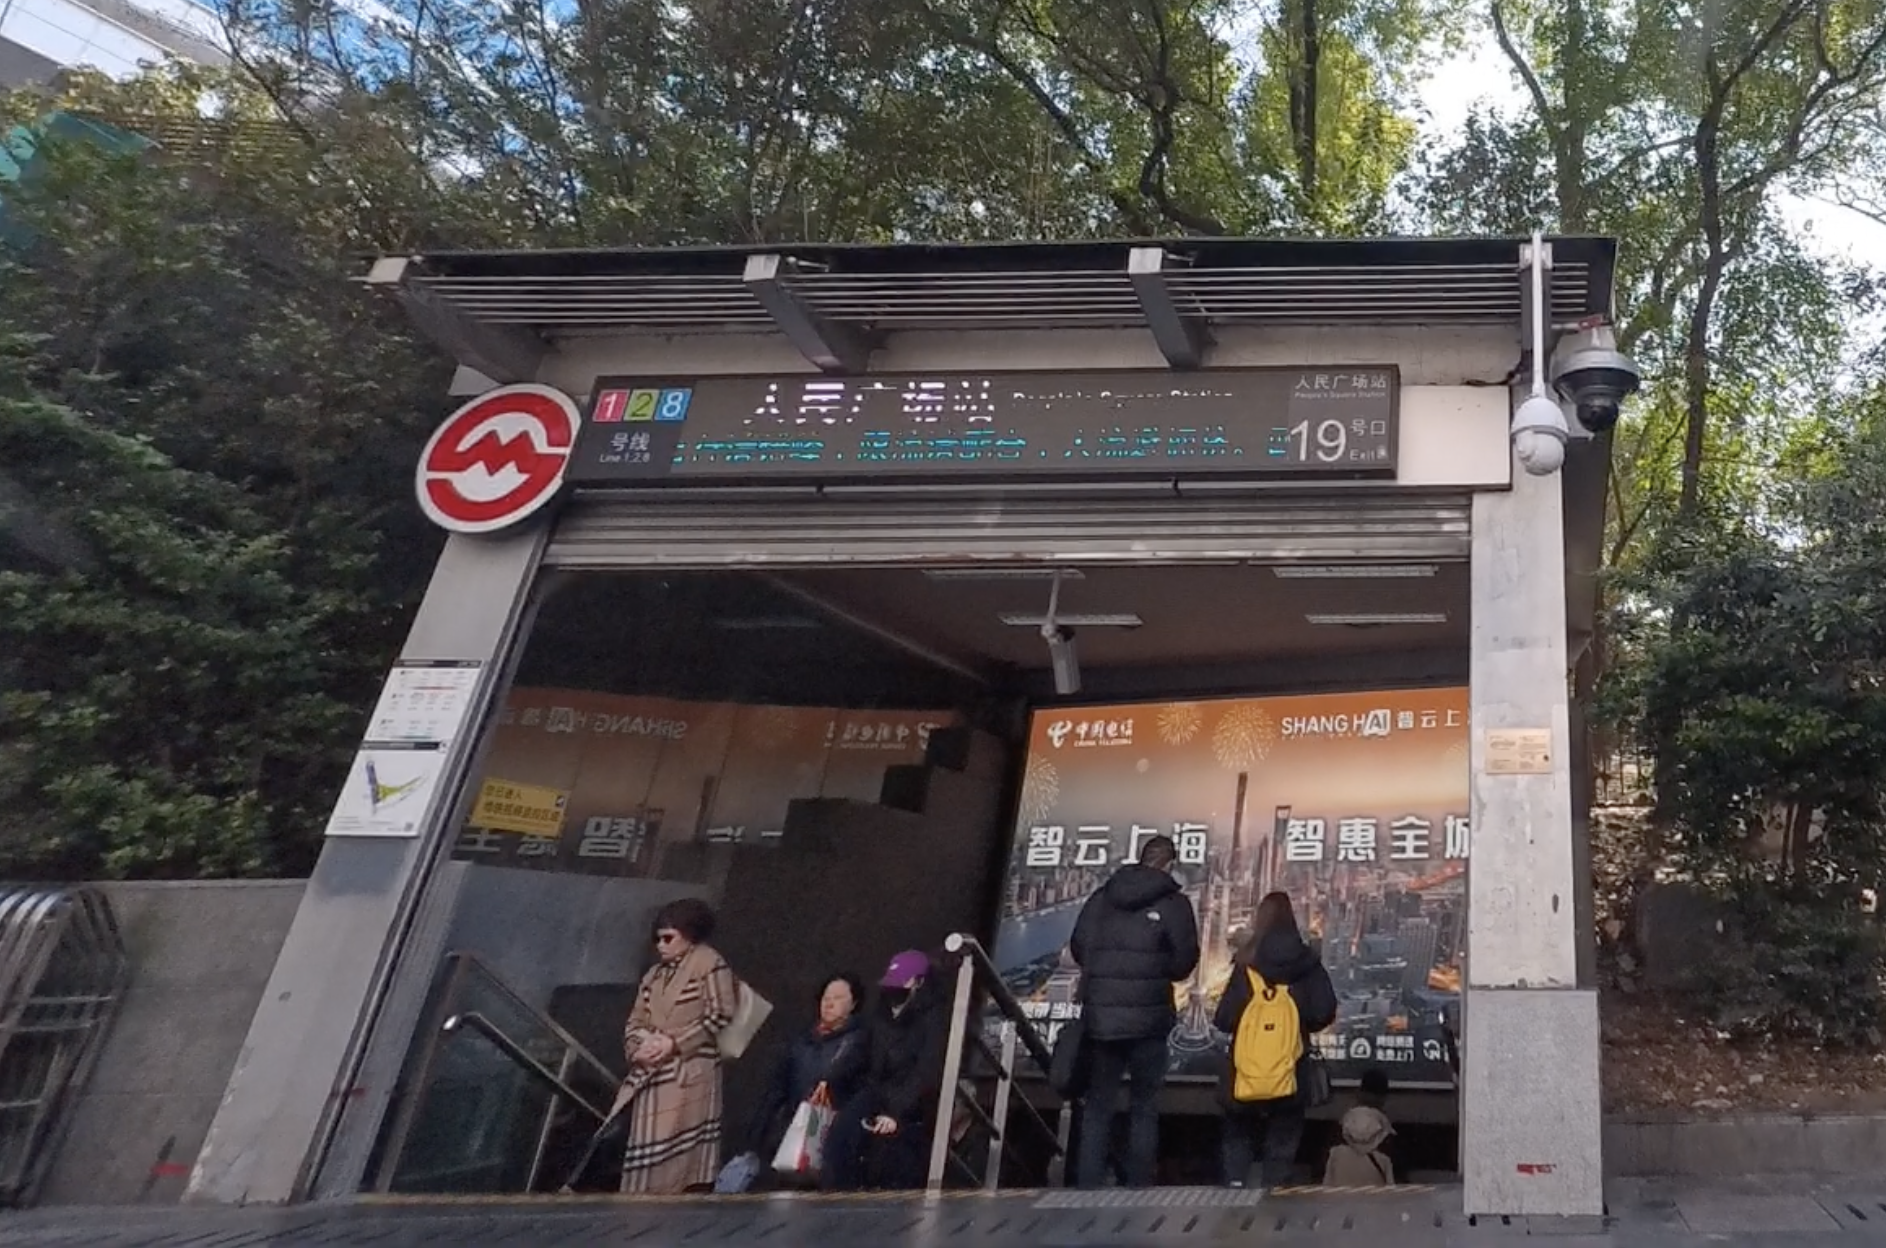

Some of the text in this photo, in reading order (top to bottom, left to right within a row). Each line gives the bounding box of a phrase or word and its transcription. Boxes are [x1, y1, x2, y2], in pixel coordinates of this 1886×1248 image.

[1294, 373, 1387, 390] 人民广场站
[631, 392, 653, 418] 2
[661, 391, 682, 418] 8
[1349, 418, 1386, 437] 号口
[610, 431, 651, 452] 号线
[1290, 419, 1346, 462] 19
[1281, 714, 1348, 735] SHANG
[1397, 709, 1470, 730] 智云上
[1026, 822, 1210, 867] 智云上海
